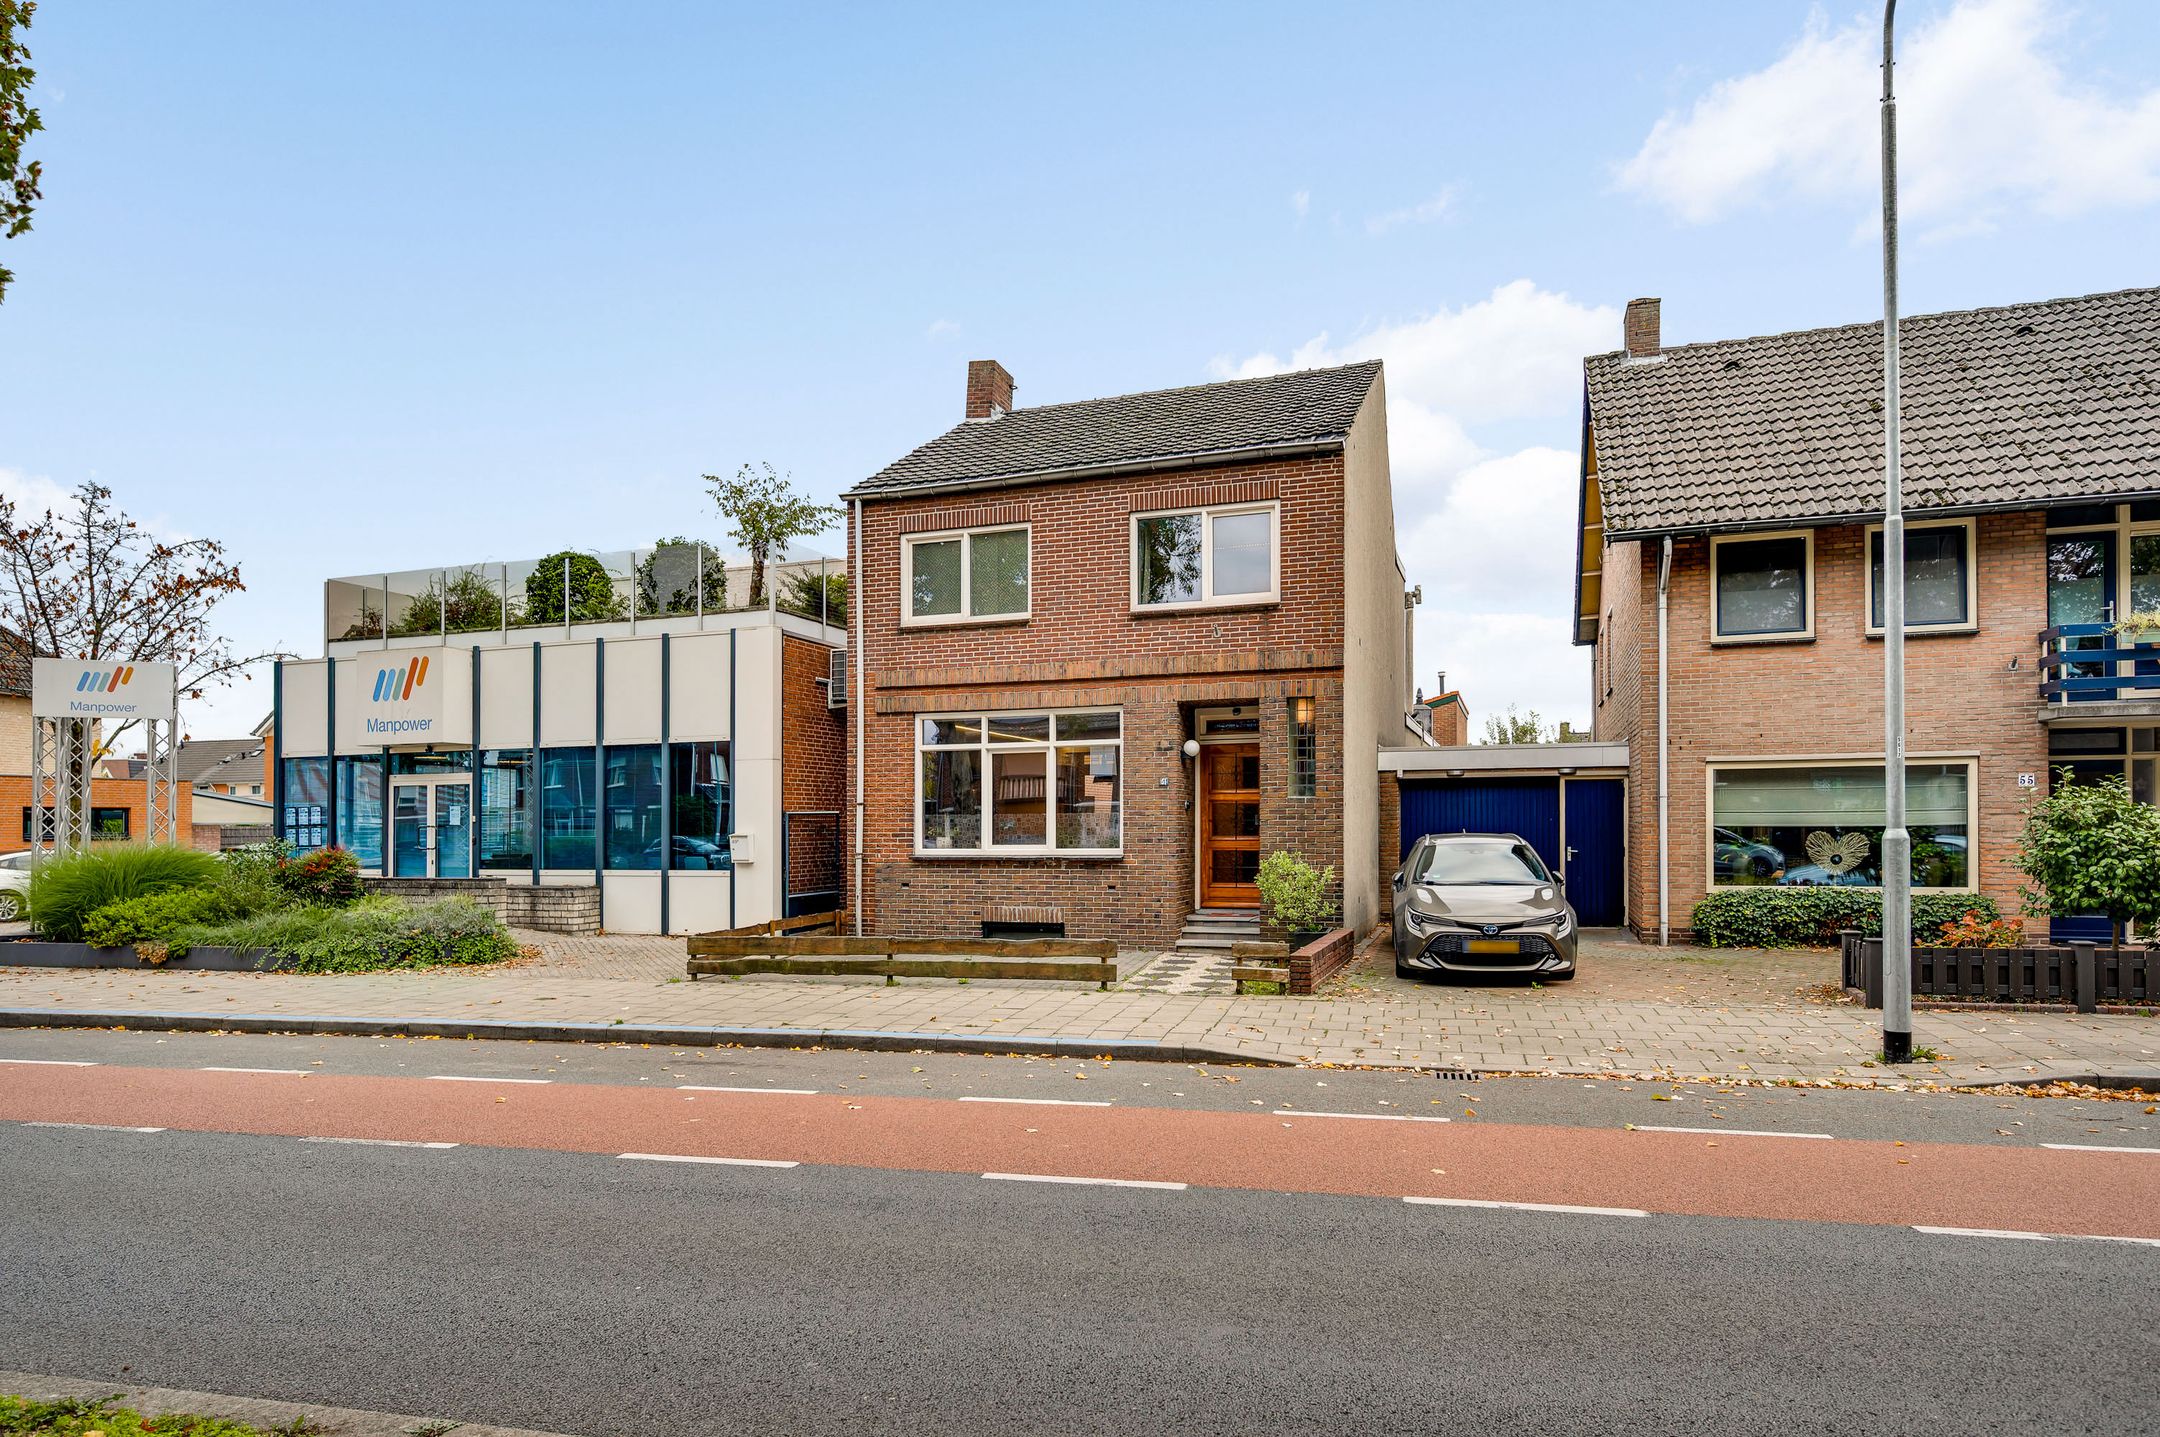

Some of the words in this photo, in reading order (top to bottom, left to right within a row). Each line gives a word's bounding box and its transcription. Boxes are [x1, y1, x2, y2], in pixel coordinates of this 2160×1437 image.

[70, 701, 137, 714] Manpower
[367, 718, 433, 736] Manpower
[2019, 775, 2034, 785] 55
